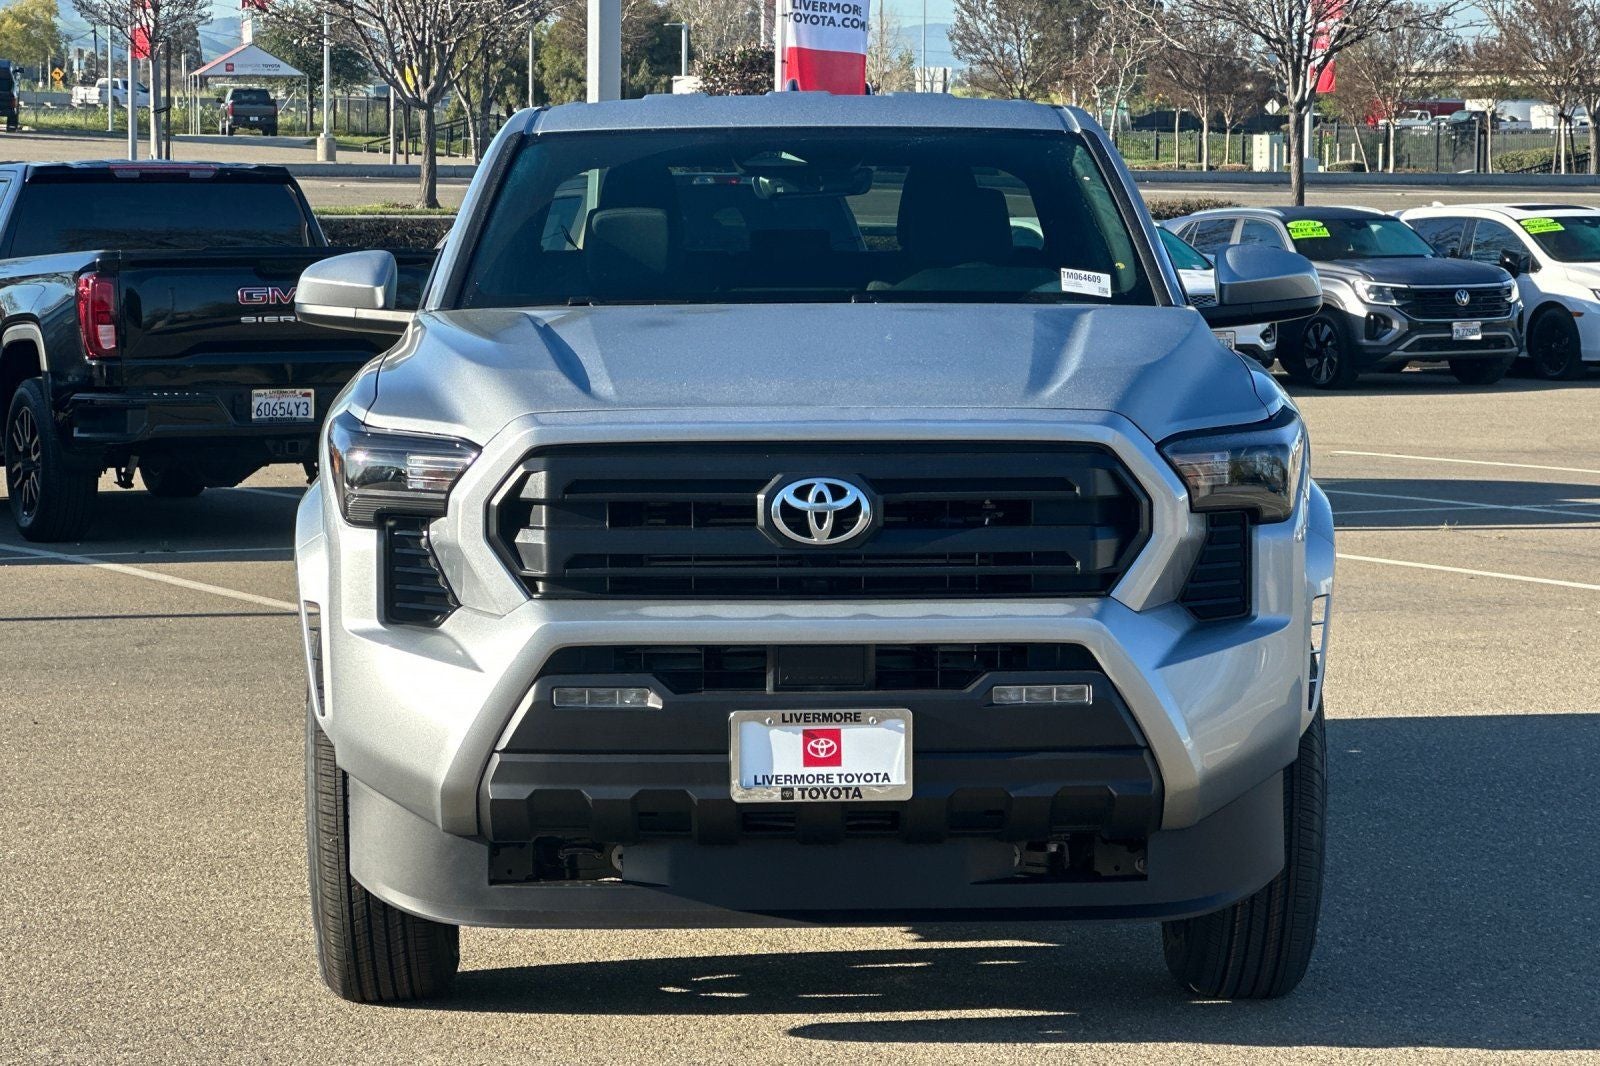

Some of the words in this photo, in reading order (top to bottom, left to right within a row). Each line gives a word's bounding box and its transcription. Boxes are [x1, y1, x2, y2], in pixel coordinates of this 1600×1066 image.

[792, 0, 862, 17] LIVERMORE
[1061, 271, 1102, 284] TM064609
[237, 286, 298, 305] GM
[240, 315, 297, 323] SIER
[255, 401, 310, 417] 60654Y3
[781, 711, 862, 724] LIVERMORE
[753, 773, 835, 786] LIVERMORE
[836, 772, 891, 784] TOYOTA
[797, 786, 863, 800] TOYOTA
